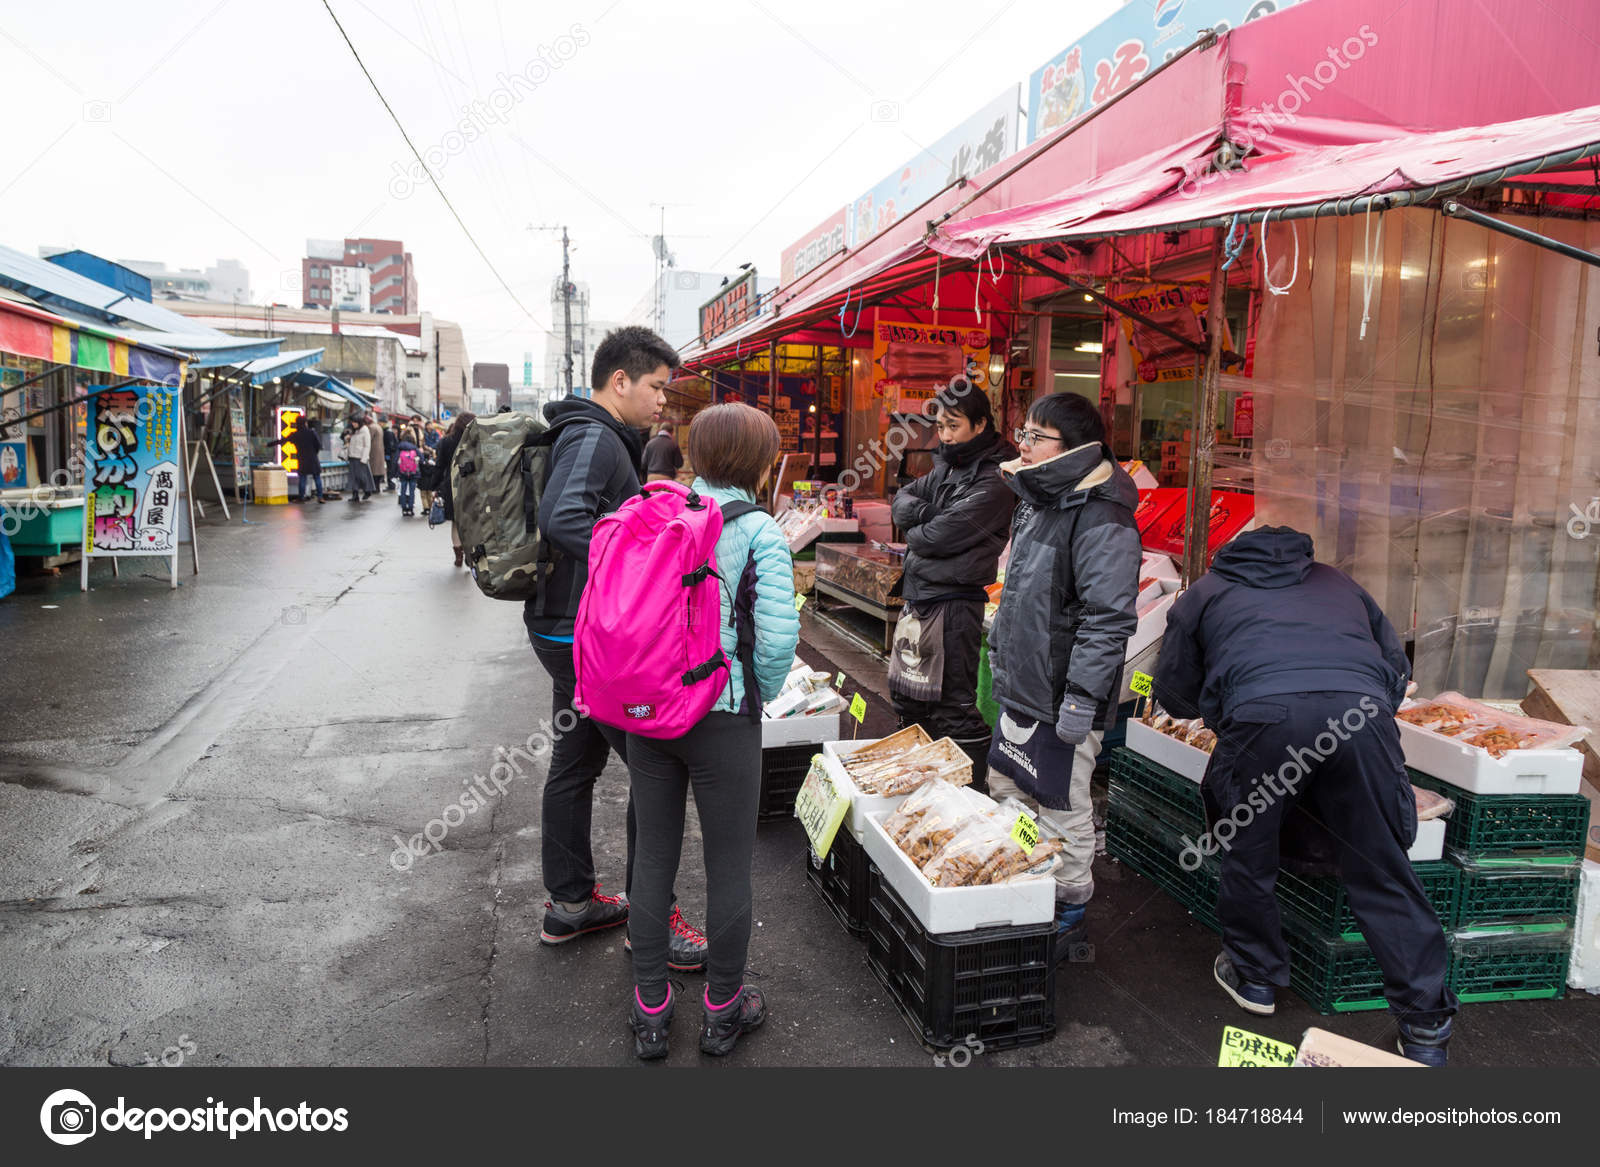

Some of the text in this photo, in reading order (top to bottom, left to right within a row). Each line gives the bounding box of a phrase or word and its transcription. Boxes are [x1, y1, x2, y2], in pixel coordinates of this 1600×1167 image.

[147, 471, 173, 525] 高田屋
[627, 704, 651, 715] cabin
